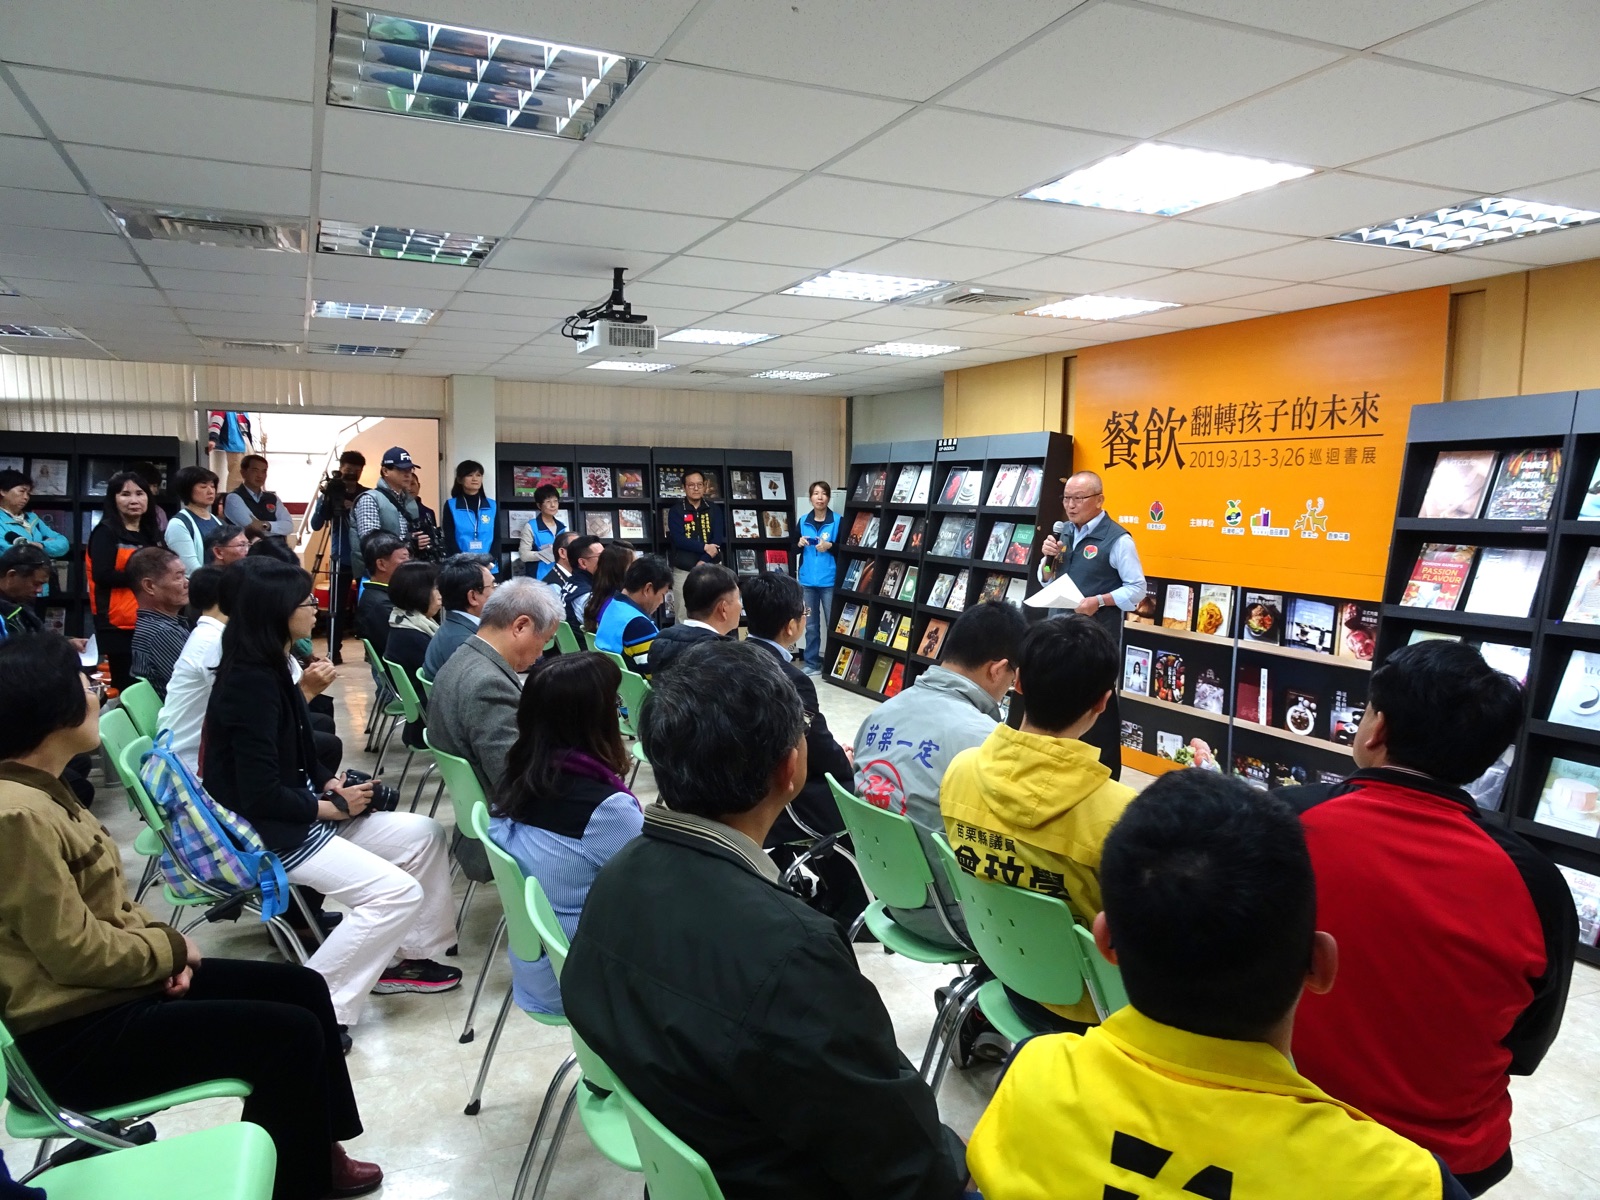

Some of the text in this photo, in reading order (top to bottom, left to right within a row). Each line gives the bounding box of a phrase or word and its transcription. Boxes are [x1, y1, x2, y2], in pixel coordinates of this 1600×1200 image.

[1190, 391, 1382, 437] 翻轉孩子的未來
[1101, 406, 1188, 471] 餐飲
[1189, 446, 1377, 469] 2019/3/13-3/26 巡迴書展
[1422, 567, 1459, 576] PASSION
[1422, 574, 1462, 584] FLAVOUR
[866, 724, 940, 769] 苗栗一定
[956, 823, 1017, 854] 苗栗縣議員
